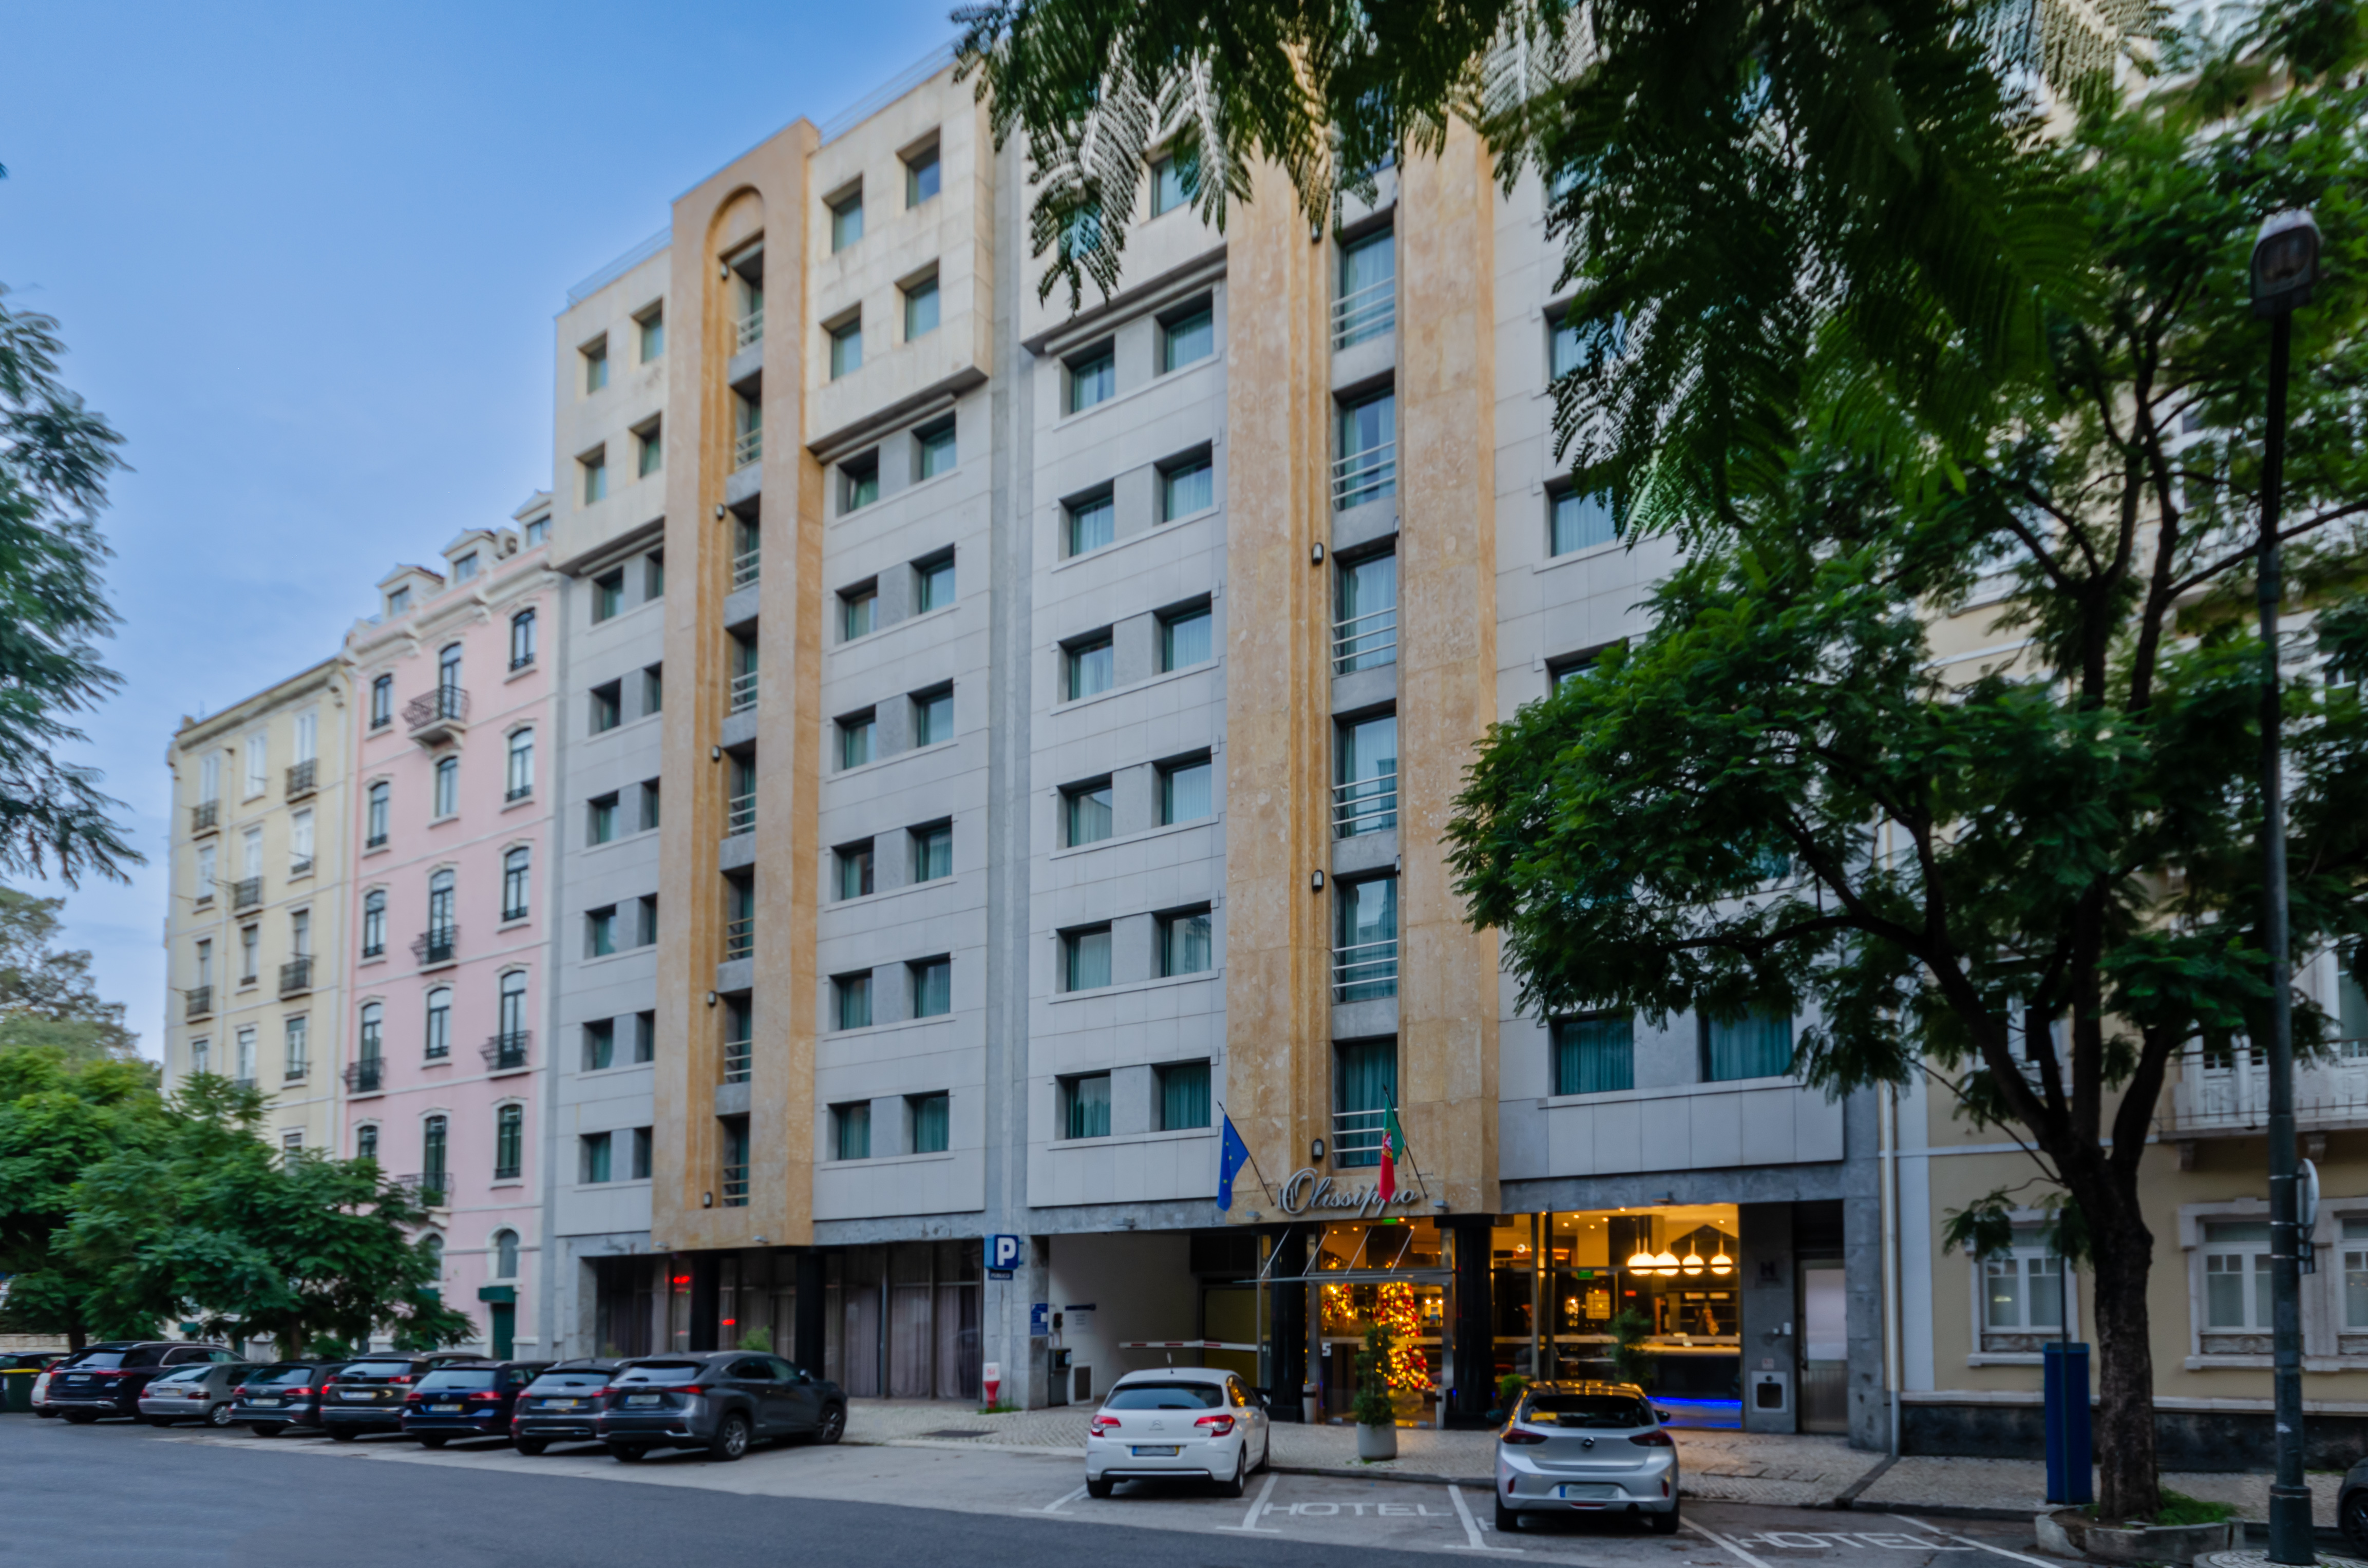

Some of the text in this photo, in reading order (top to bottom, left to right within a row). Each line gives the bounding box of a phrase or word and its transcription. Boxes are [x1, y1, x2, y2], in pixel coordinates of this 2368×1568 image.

[997, 1237, 1016, 1266] P
[1322, 1342, 1332, 1356] 5
[1261, 1502, 1453, 1516] HOTEL
[1721, 1532, 1976, 1550] HOTEL
